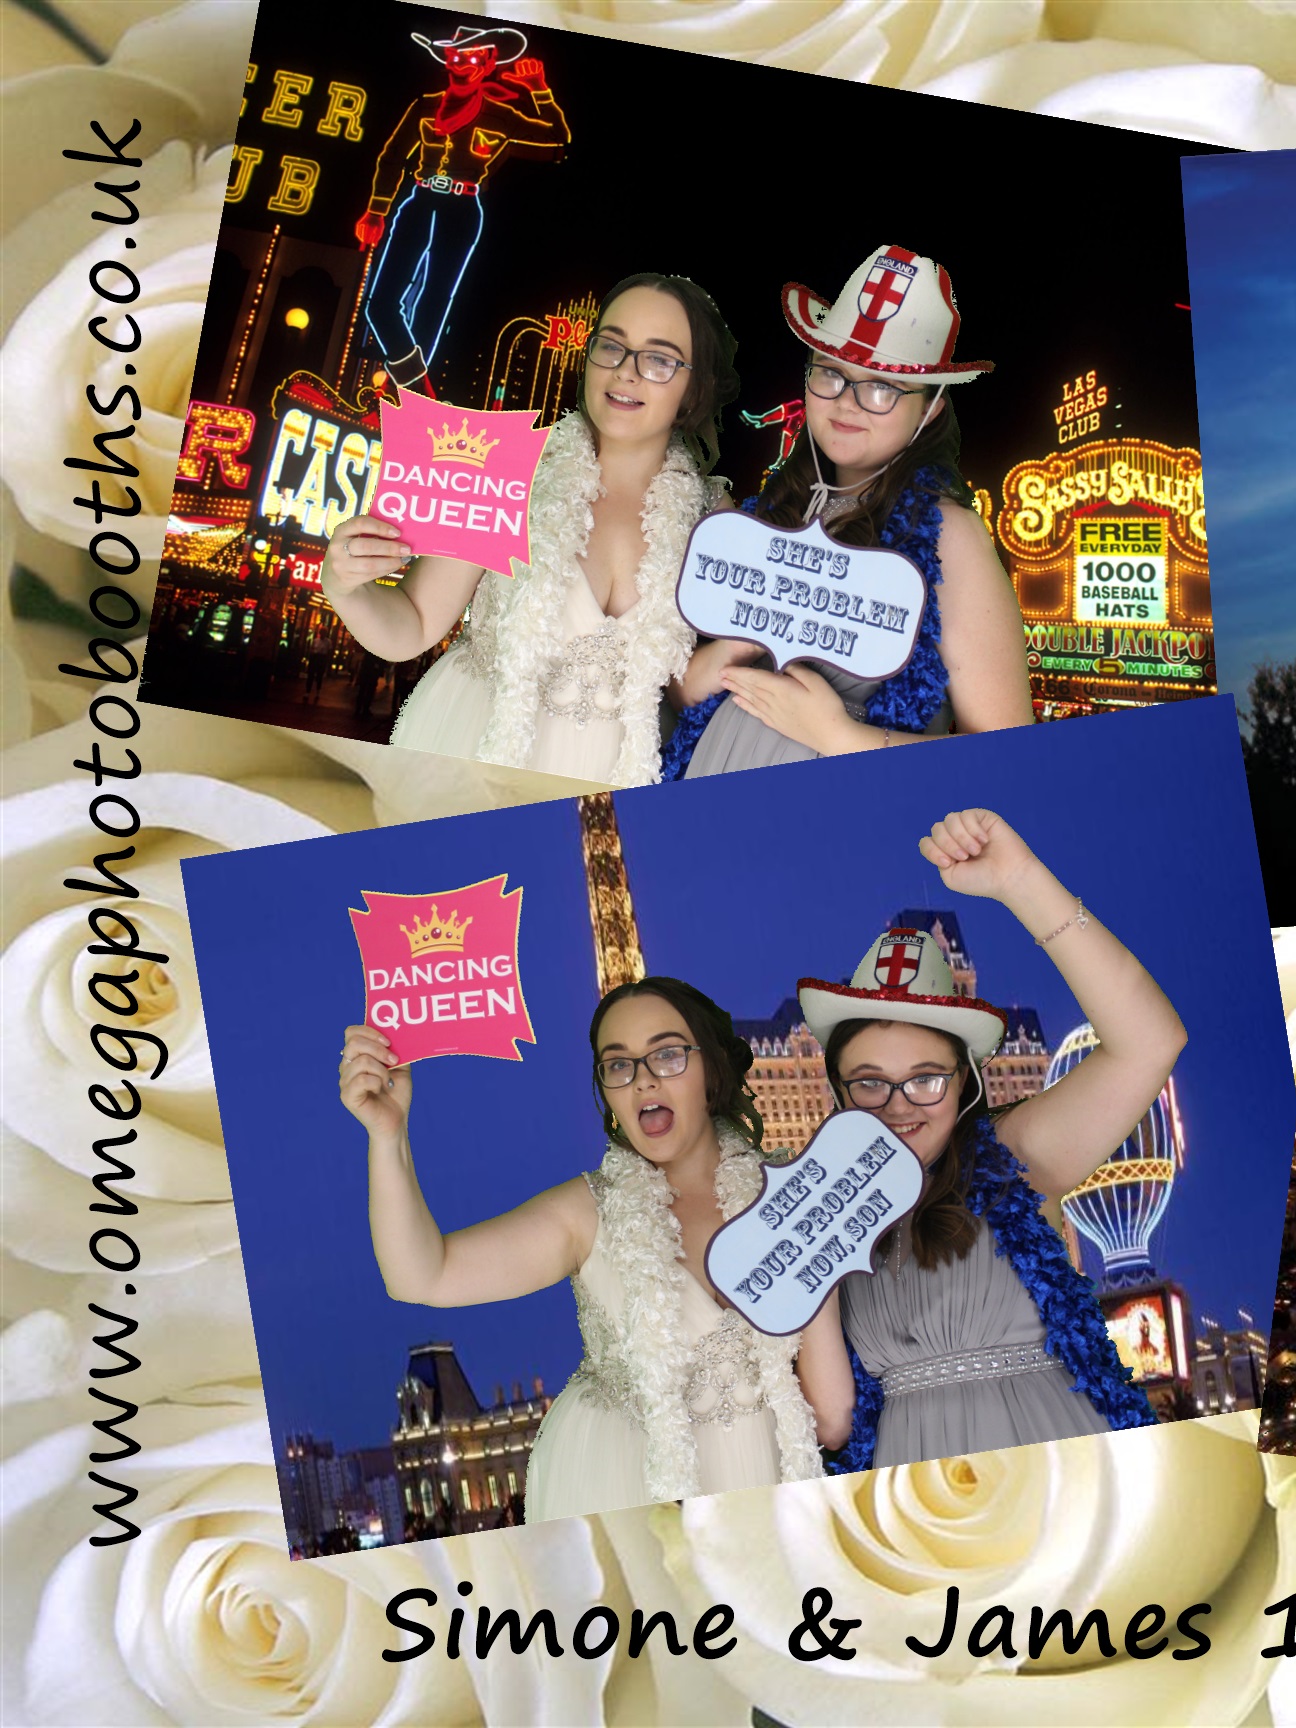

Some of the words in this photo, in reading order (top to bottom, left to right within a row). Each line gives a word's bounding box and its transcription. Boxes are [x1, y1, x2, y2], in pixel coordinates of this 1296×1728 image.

[238, 62, 369, 142] ER
[876, 256, 916, 275] ENGLAND
[1062, 370, 1097, 401] LAS
[1053, 386, 1108, 425] VEGAS
[1058, 412, 1101, 444] CLUB
[382, 460, 527, 501] DANCING
[377, 491, 524, 537] QUEEN
[1080, 522, 1162, 542] FREE
[766, 536, 850, 579] SHE'S
[1080, 543, 1162, 554] EVERYDAY
[1082, 561, 1157, 583] 1000
[695, 553, 766, 595] YOUR
[770, 574, 910, 634] PROBLEM
[1081, 585, 1159, 601] BASEBALL
[1095, 603, 1150, 619] HATS
[730, 599, 794, 643] NOW,
[799, 619, 859, 657] SON
[1041, 656, 1093, 672] EVERY
[1097, 657, 1121, 676] 5
[1125, 661, 1204, 679] MINUTES
[882, 935, 923, 944] ENGLAND
[368, 954, 513, 991] DANCING
[370, 986, 517, 1031] QUEEN
[758, 1158, 827, 1231] SHE'S
[733, 1238, 803, 1304] YOUR
[792, 1135, 898, 1246] PROBLEM
[793, 1234, 857, 1295] NOW,
[843, 1188, 894, 1243] SON
